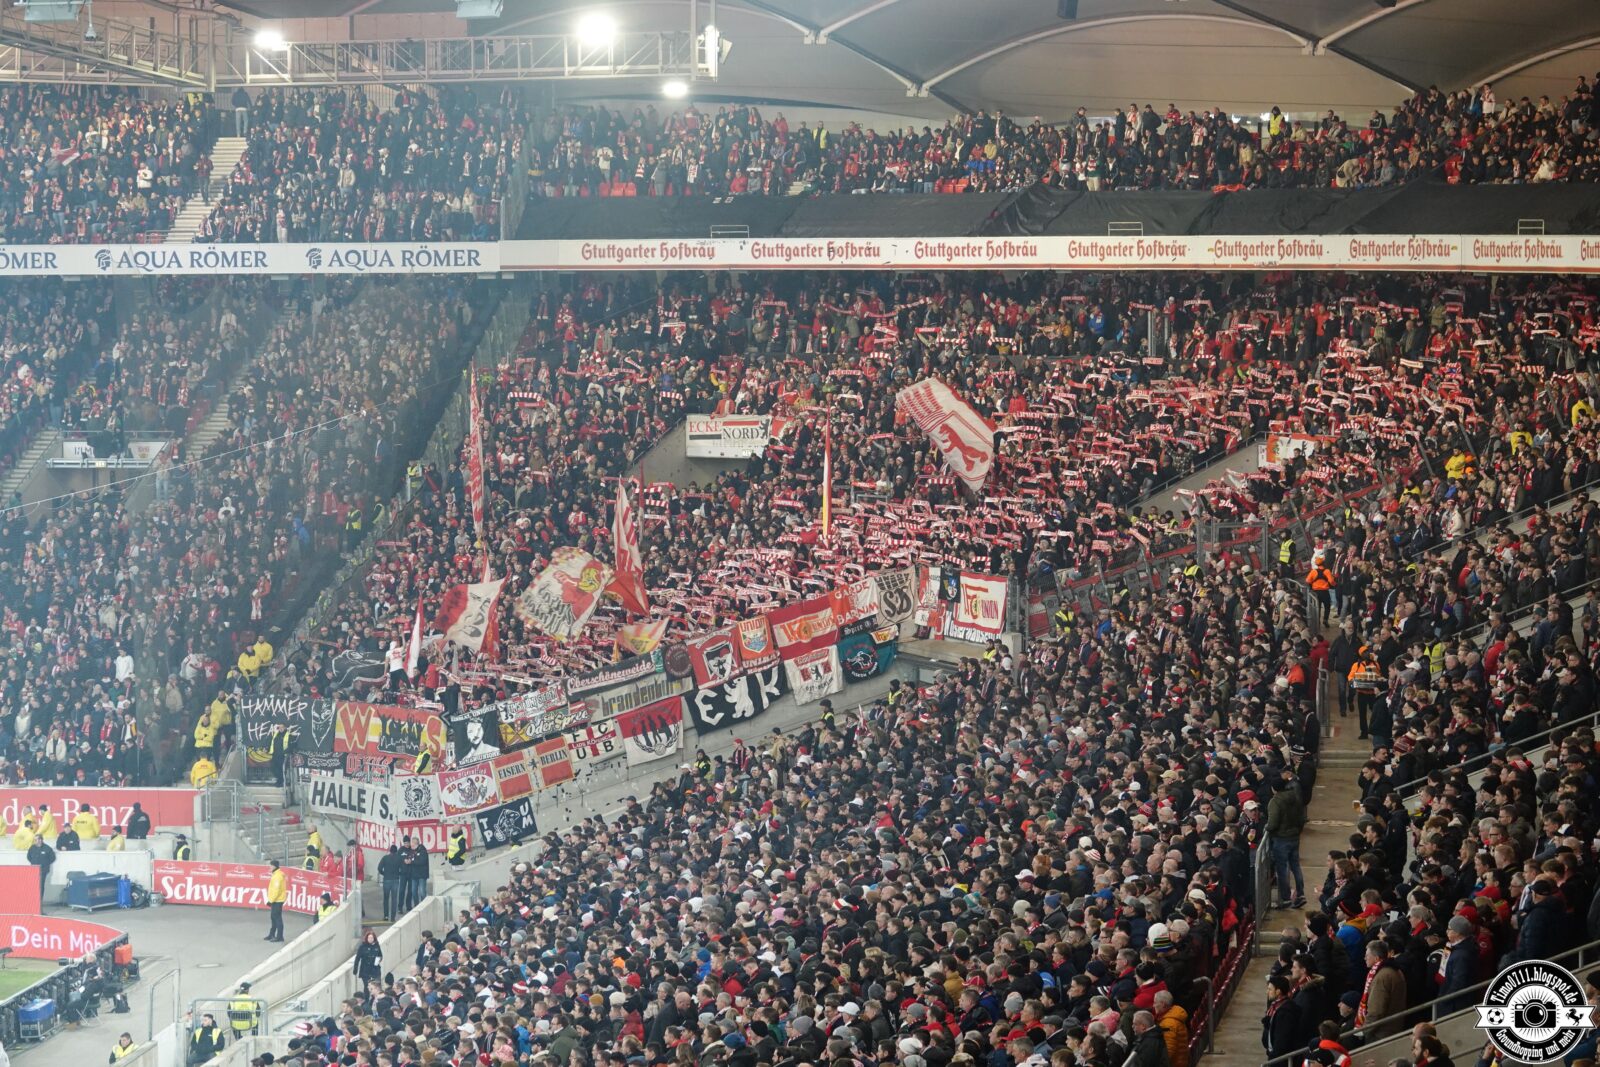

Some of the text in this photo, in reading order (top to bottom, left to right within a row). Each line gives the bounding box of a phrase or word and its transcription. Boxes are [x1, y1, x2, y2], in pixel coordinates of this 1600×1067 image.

[117, 246, 268, 271] AQUA RÖMER
[328, 245, 481, 271] AQUA RÖMER
[582, 241, 715, 263] Stuttgarter Hofbräu
[751, 240, 880, 262] Stuttgarter Hofbräu
[914, 240, 1037, 262] Stuttgarter Hofbräu
[1068, 239, 1186, 261] Stuttgarter Hofbräu
[1214, 238, 1323, 261] Stuttgarter Hofbräu
[1350, 238, 1450, 262] Stuttgarter Hofbräu
[1473, 238, 1562, 263] Stuttgarter Hofbräu
[689, 420, 721, 433] ECKE
[723, 427, 760, 440] NORD
[835, 581, 870, 600] GARDE
[835, 602, 879, 626] BARNIM
[566, 660, 656, 696] Oberschöneweide
[695, 688, 725, 726] E
[755, 665, 781, 710] K
[240, 697, 308, 721] HAMMER
[337, 703, 444, 758] W S
[597, 722, 608, 735] C
[576, 739, 614, 760] U B
[498, 763, 526, 779] EISERN
[540, 749, 568, 766] BERLIN
[312, 781, 366, 814] HALLE
[379, 793, 394, 821] S.
[402, 808, 434, 818] NINERS
[11, 925, 62, 950] Dein
